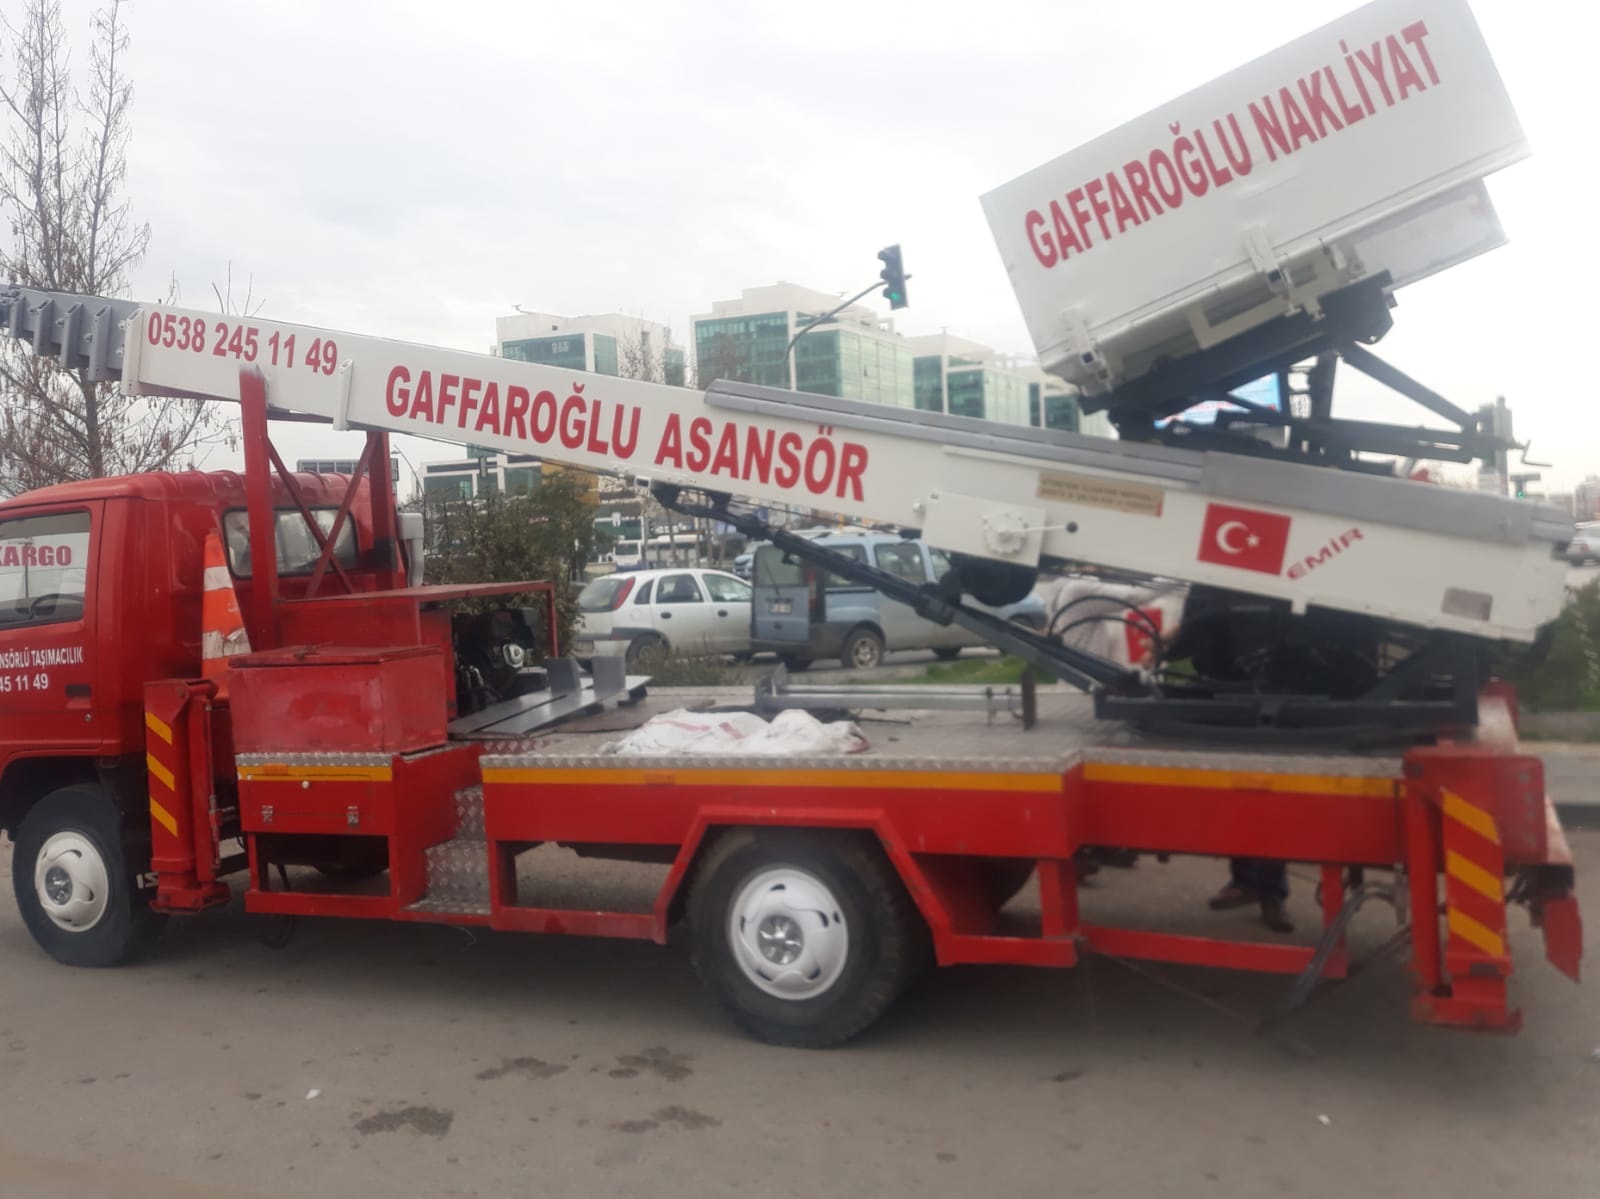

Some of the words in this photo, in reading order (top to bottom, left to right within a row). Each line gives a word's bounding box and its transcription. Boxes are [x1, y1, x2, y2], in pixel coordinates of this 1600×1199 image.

[1025, 114, 1252, 269] GAFFAROĞLU
[1248, 20, 1440, 161] NAKLİYAT
[147, 311, 206, 353] 0538
[212, 322, 259, 362] 245
[268, 331, 296, 369] 11
[305, 338, 338, 376] 49
[385, 364, 642, 460] GAFFAROĞLU
[654, 411, 870, 502] ASANSÖR
[0, 545, 72, 567] ARGO
[15, 674, 29, 691] 11
[33, 673, 49, 690] 49
